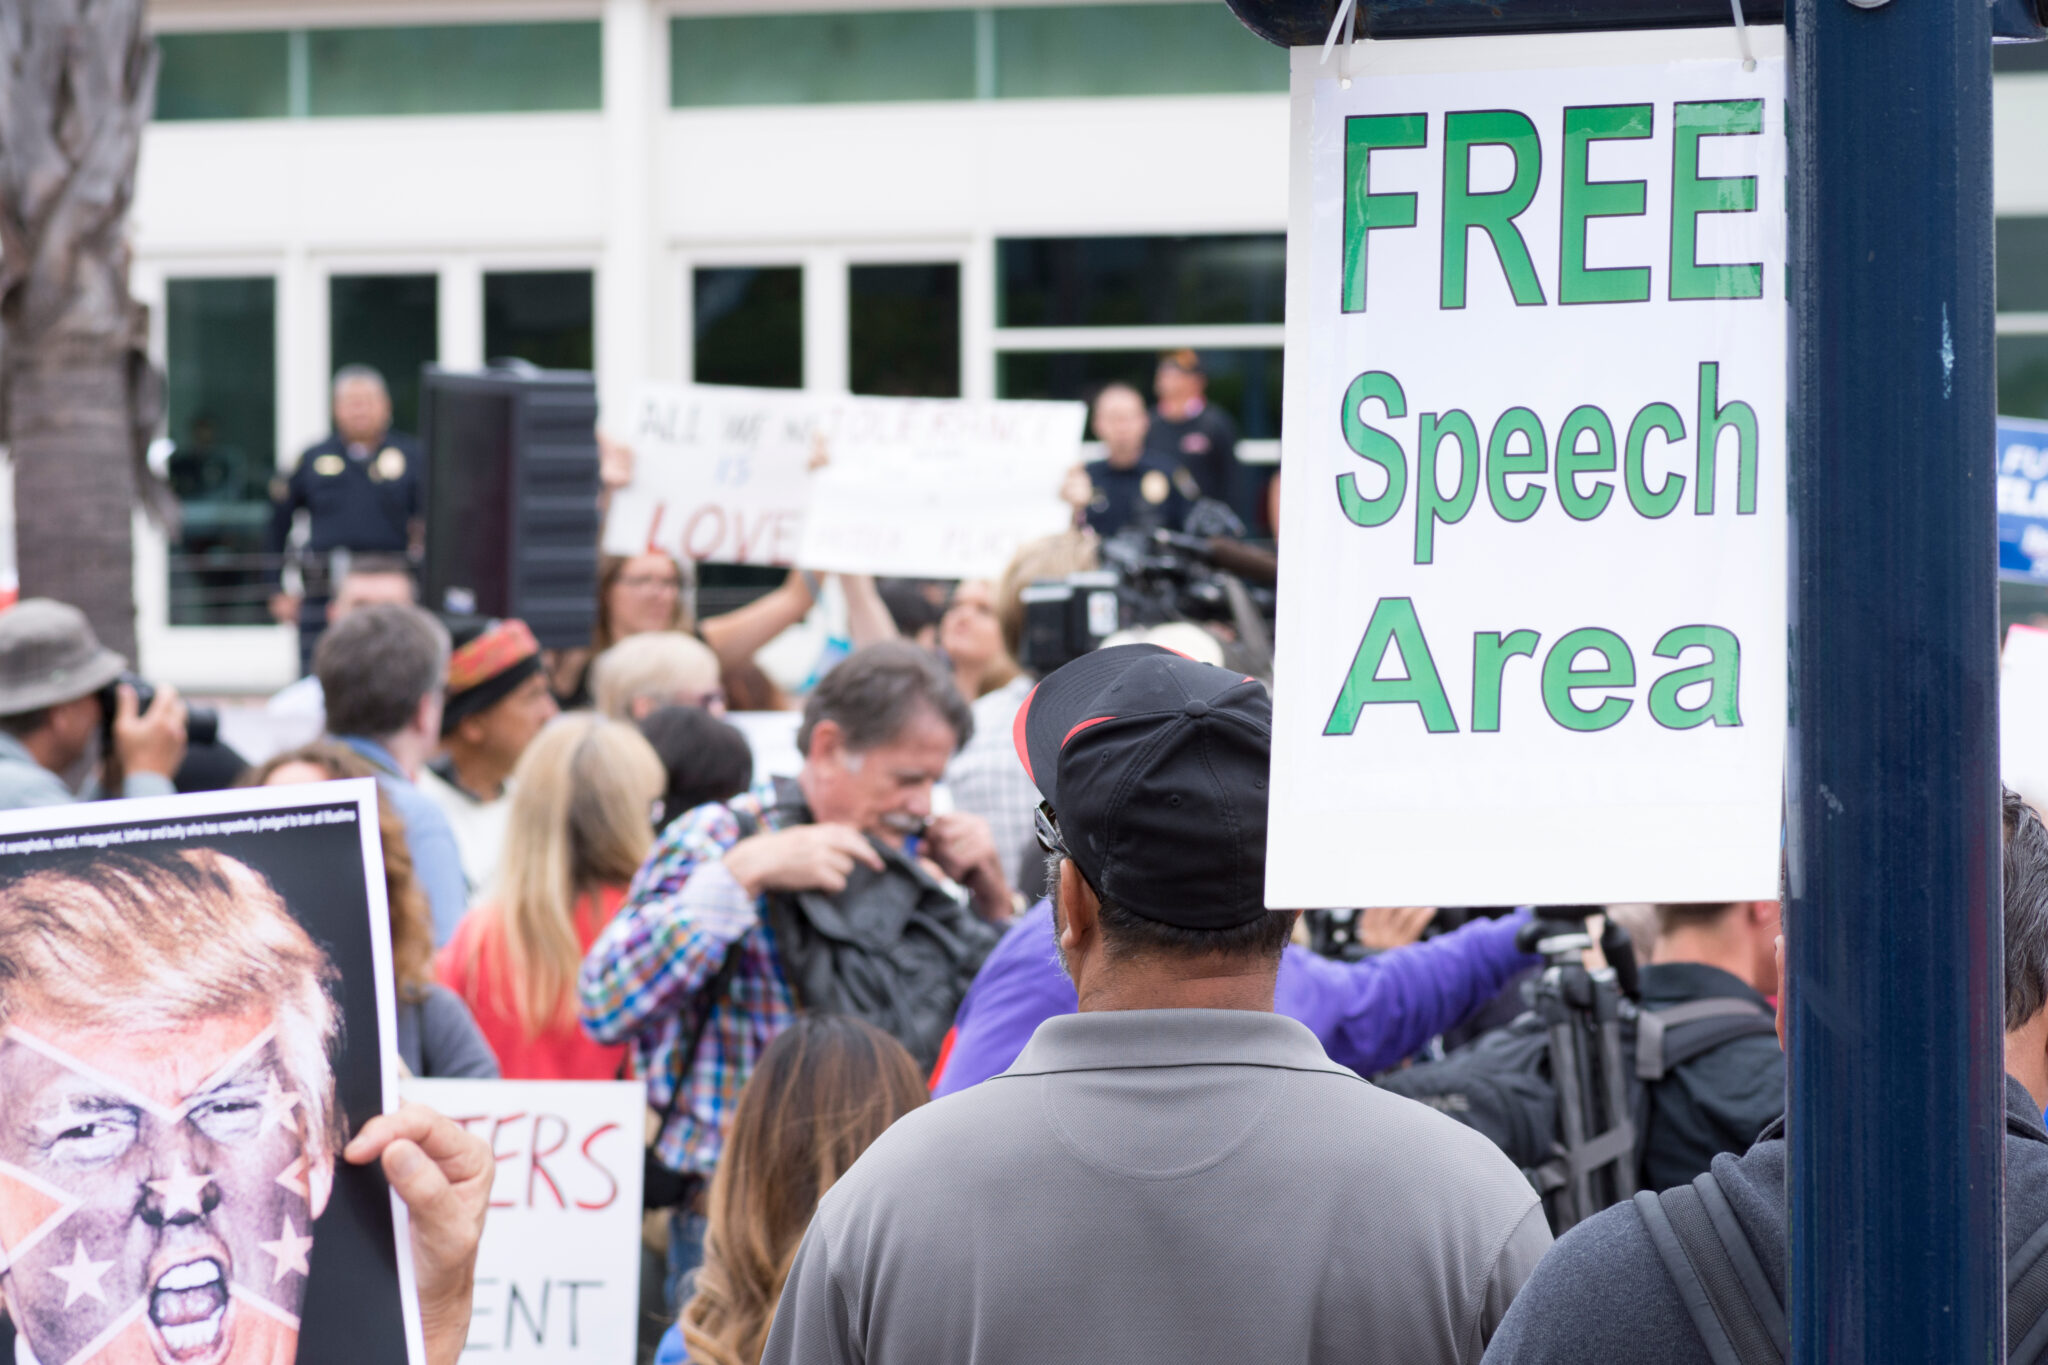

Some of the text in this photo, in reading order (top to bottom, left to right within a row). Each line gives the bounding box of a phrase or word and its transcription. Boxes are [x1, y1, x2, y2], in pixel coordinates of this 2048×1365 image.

[1341, 98, 1766, 314] FREE
[645, 500, 806, 565] LOVE
[1336, 361, 1759, 565] Speech
[1322, 597, 1744, 737] Area
